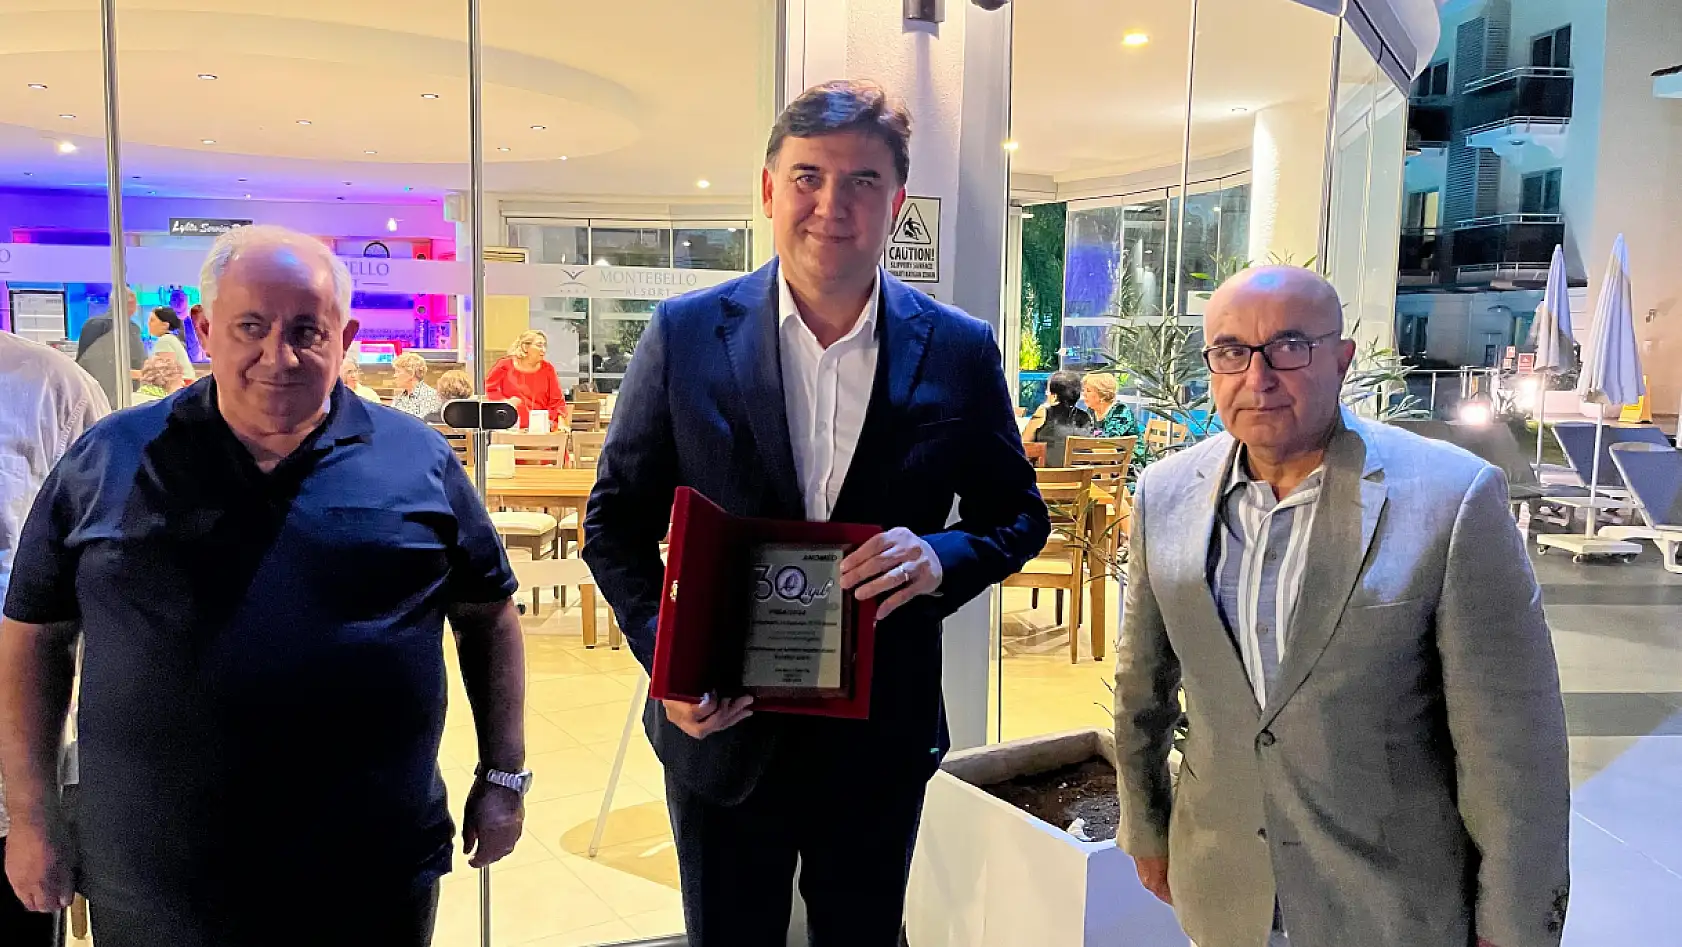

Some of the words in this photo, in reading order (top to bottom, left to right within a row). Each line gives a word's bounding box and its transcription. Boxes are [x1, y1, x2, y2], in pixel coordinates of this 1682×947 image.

[889, 247, 935, 261] CAUTION!
[599, 269, 697, 286] MONTEBELLO
[625, 287, 670, 297] RESORT
